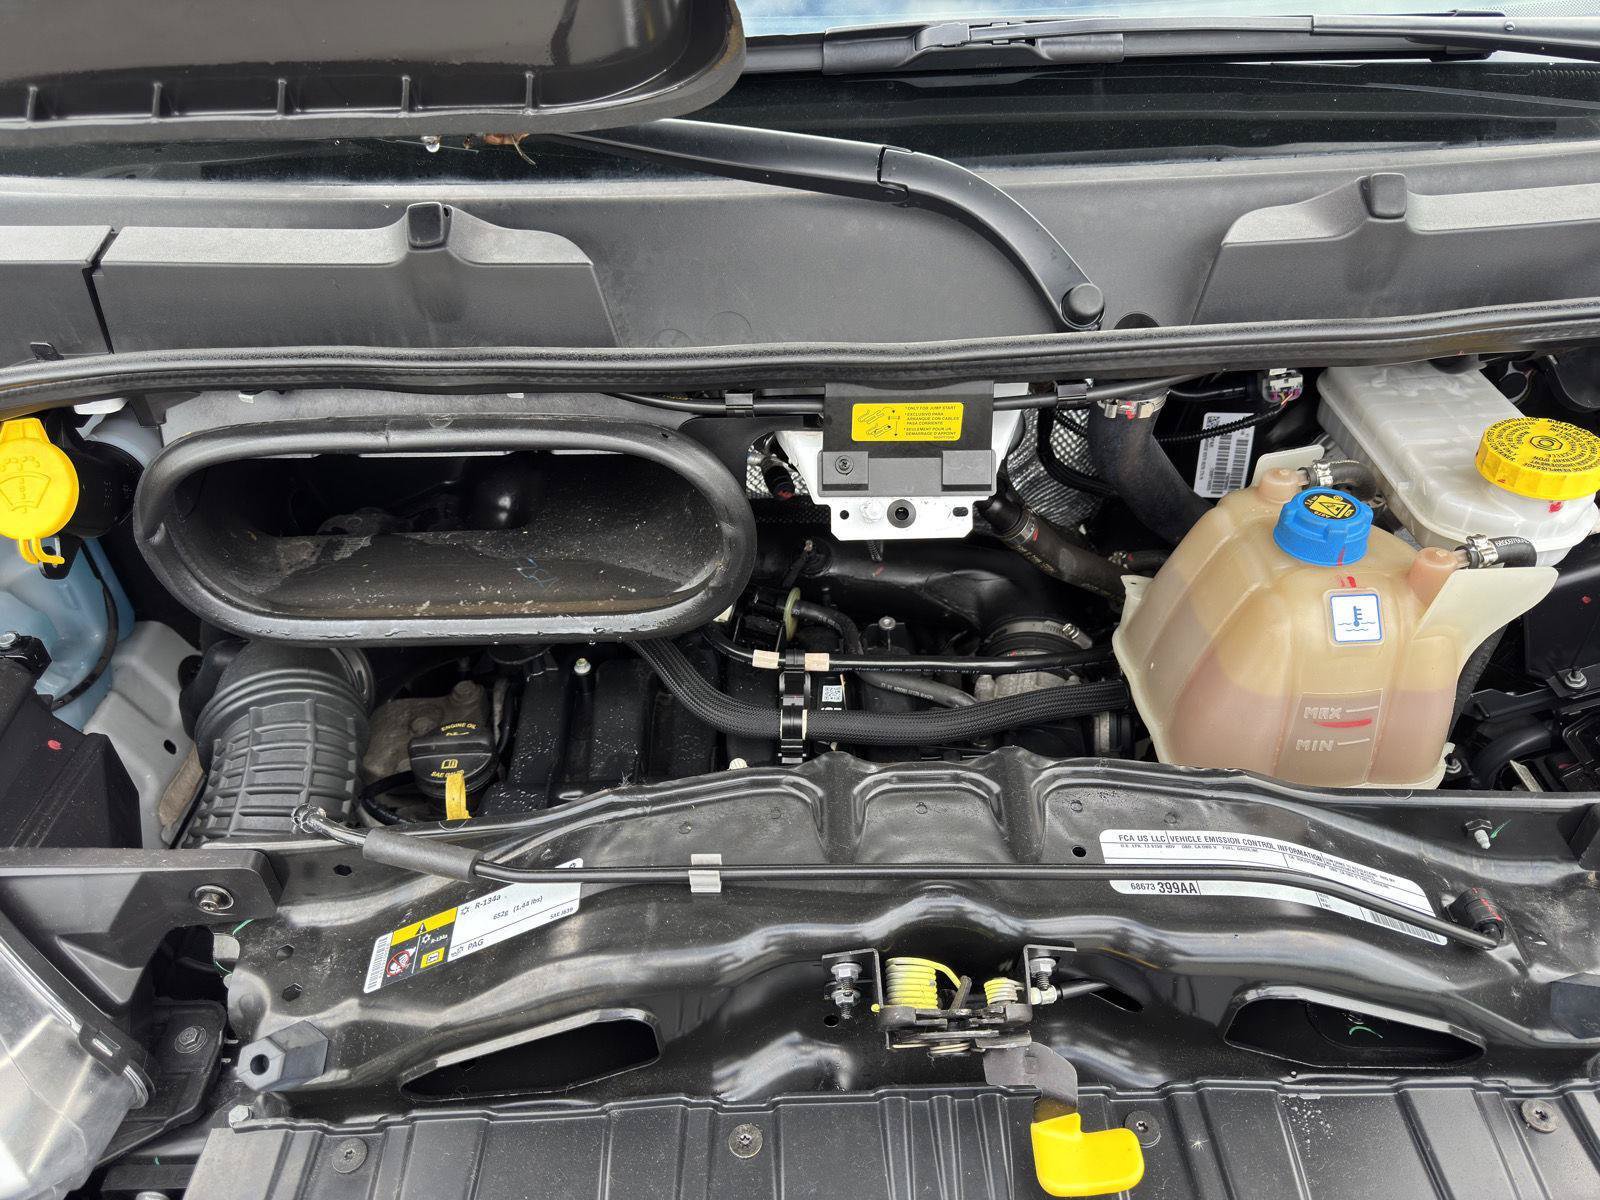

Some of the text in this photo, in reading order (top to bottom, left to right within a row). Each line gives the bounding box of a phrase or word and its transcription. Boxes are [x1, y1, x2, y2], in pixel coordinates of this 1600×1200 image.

[1303, 706, 1342, 720] MAX
[441, 722, 477, 732] ENGINE OIL
[1295, 739, 1335, 752] MIN
[1118, 834, 1135, 843] FCA
[1137, 834, 1149, 843] US
[1150, 834, 1166, 843] LLC
[1168, 835, 1201, 843] VEHICLE
[1203, 835, 1241, 845] EMISSION
[1242, 838, 1275, 849] CONTROL
[1277, 844, 1323, 861] INFORMATION
[1130, 881, 1198, 894] 68673 399AA
[474, 895, 501, 911] R-134a
[530, 895, 543, 907] lbs)
[549, 910, 562, 920] SAE
[467, 938, 484, 951] PAG
